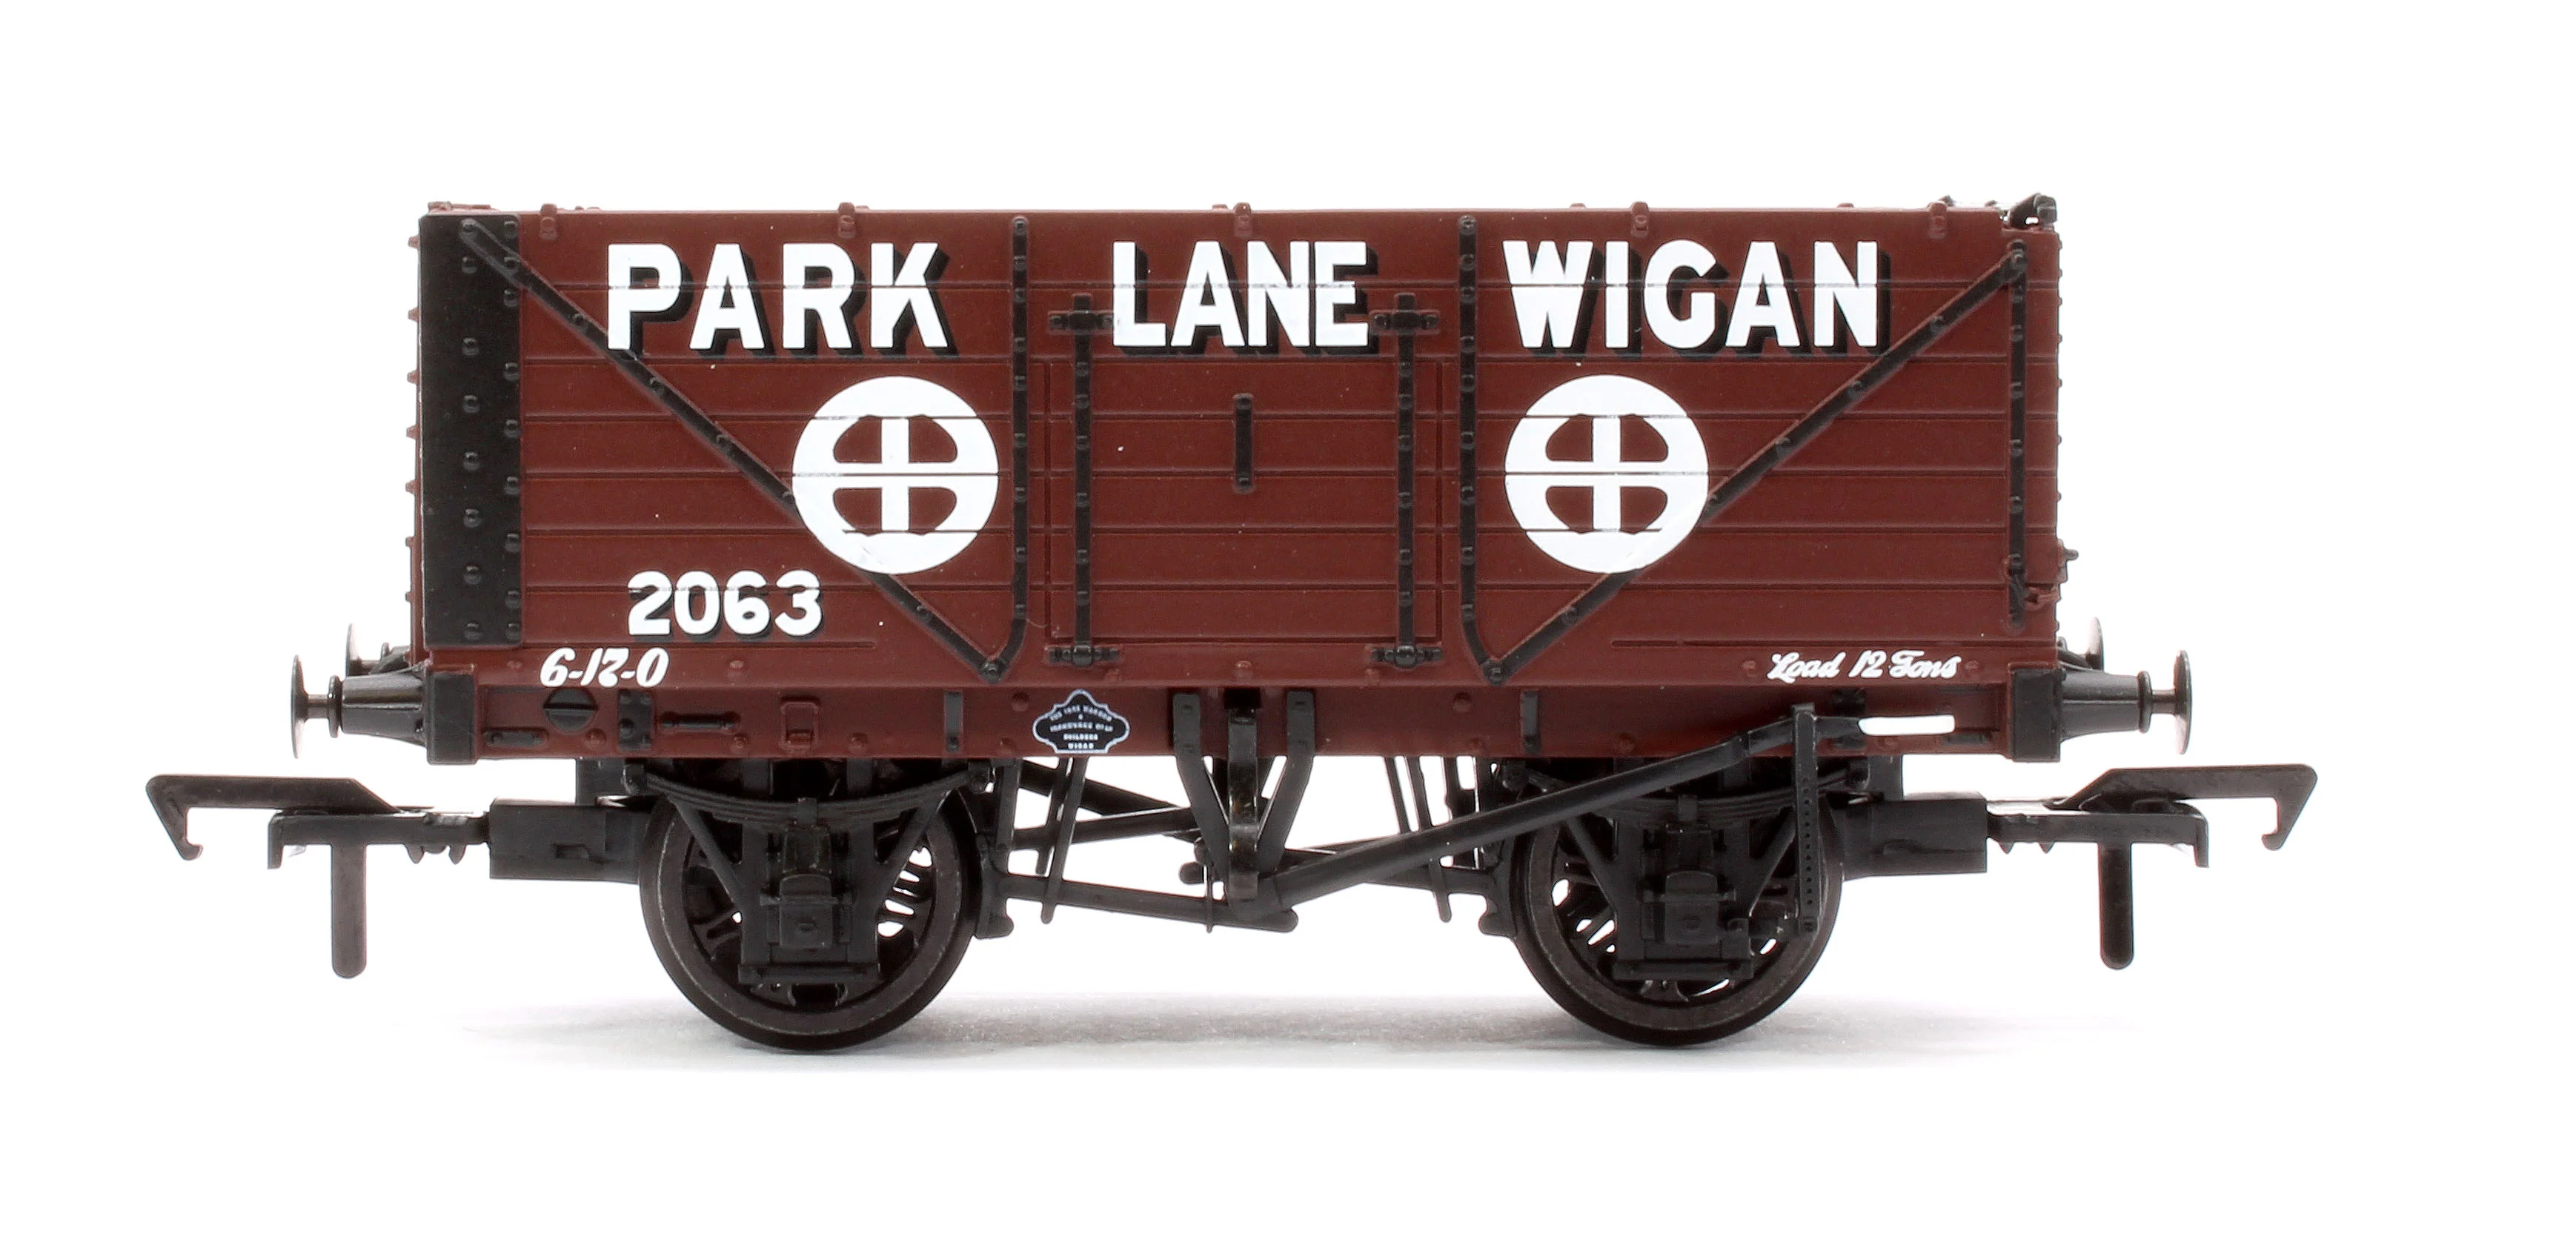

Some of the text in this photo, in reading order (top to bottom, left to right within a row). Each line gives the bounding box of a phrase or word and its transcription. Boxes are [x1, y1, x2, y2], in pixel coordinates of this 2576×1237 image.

[607, 239, 1878, 350] PARK LANE WIGAN
[627, 570, 823, 636] 2063
[1767, 650, 1962, 683] Load 12 Tons
